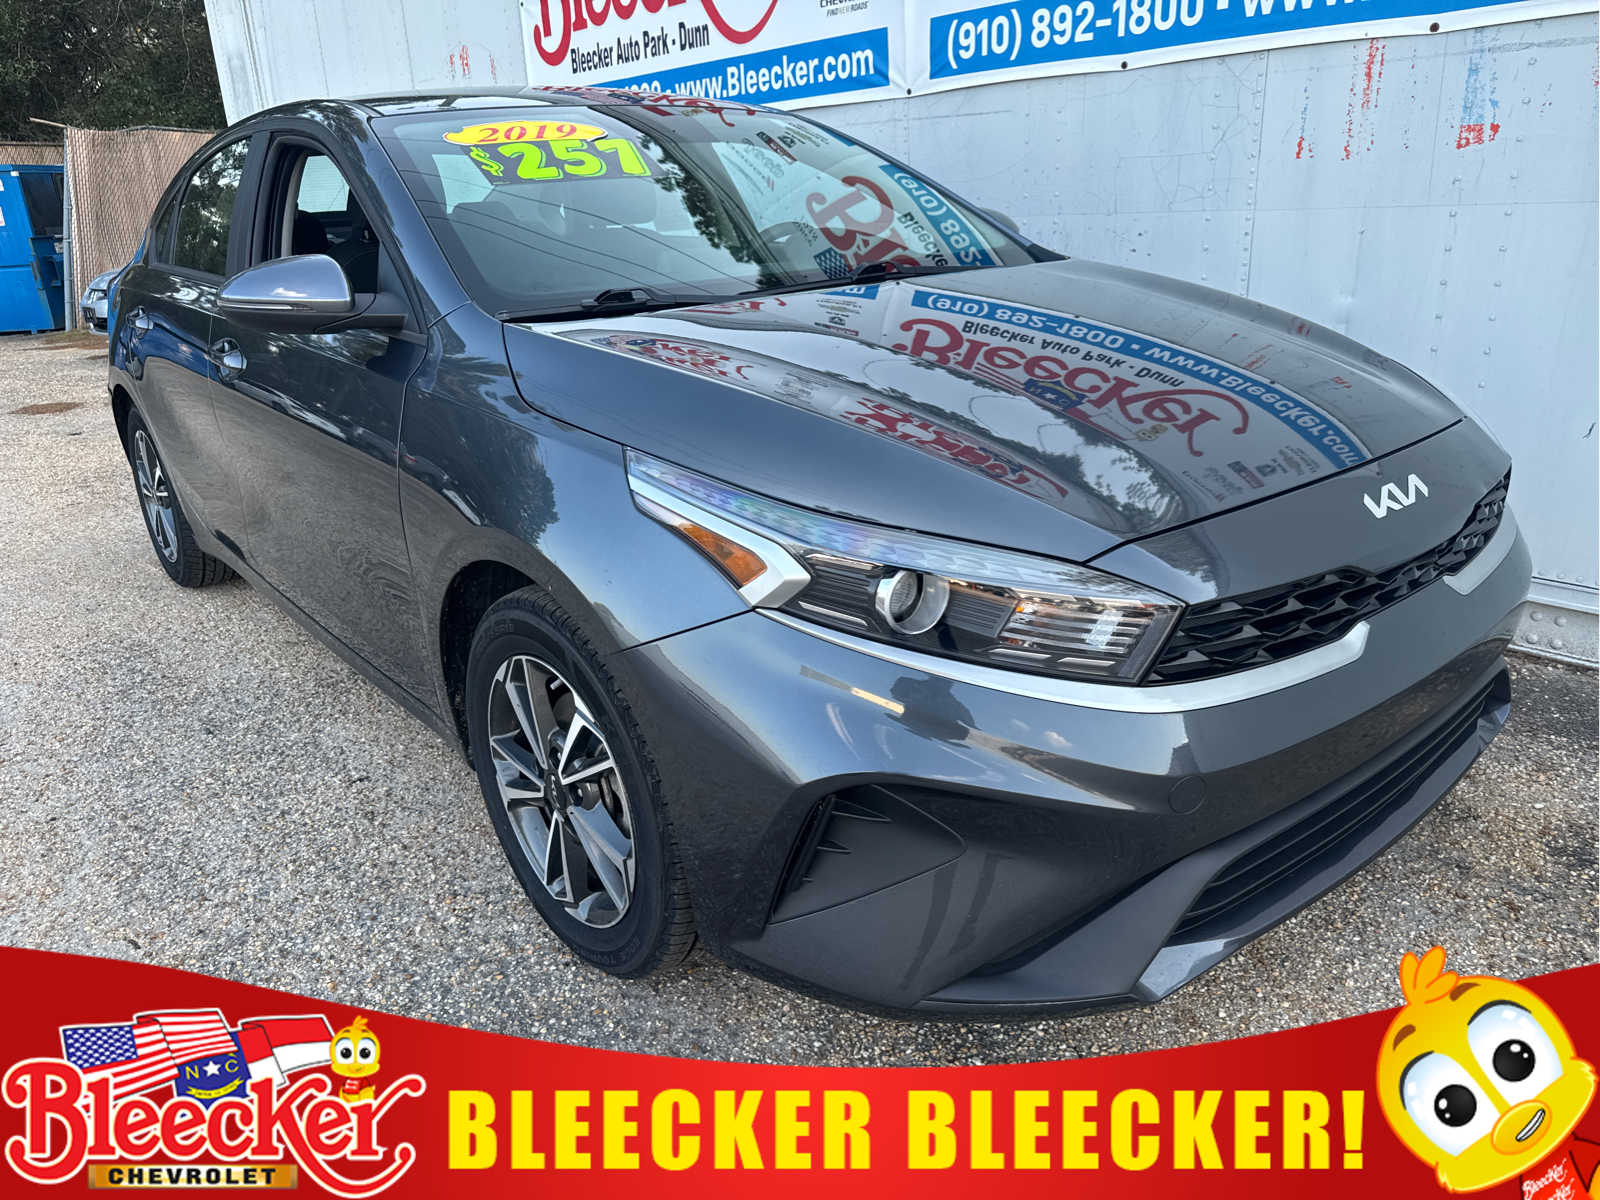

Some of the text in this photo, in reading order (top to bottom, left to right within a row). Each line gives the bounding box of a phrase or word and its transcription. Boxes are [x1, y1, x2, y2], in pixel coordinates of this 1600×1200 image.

[570, 42, 614, 74] Bleecker
[617, 36, 641, 65] Auto
[642, 26, 670, 59] Park
[678, 21, 710, 52] Dunn
[947, 0, 1204, 70] (910) 892-1800
[675, 48, 875, 100] www.Bleecker.com
[477, 123, 578, 142] 2019
[1363, 473, 1429, 519] KIA
